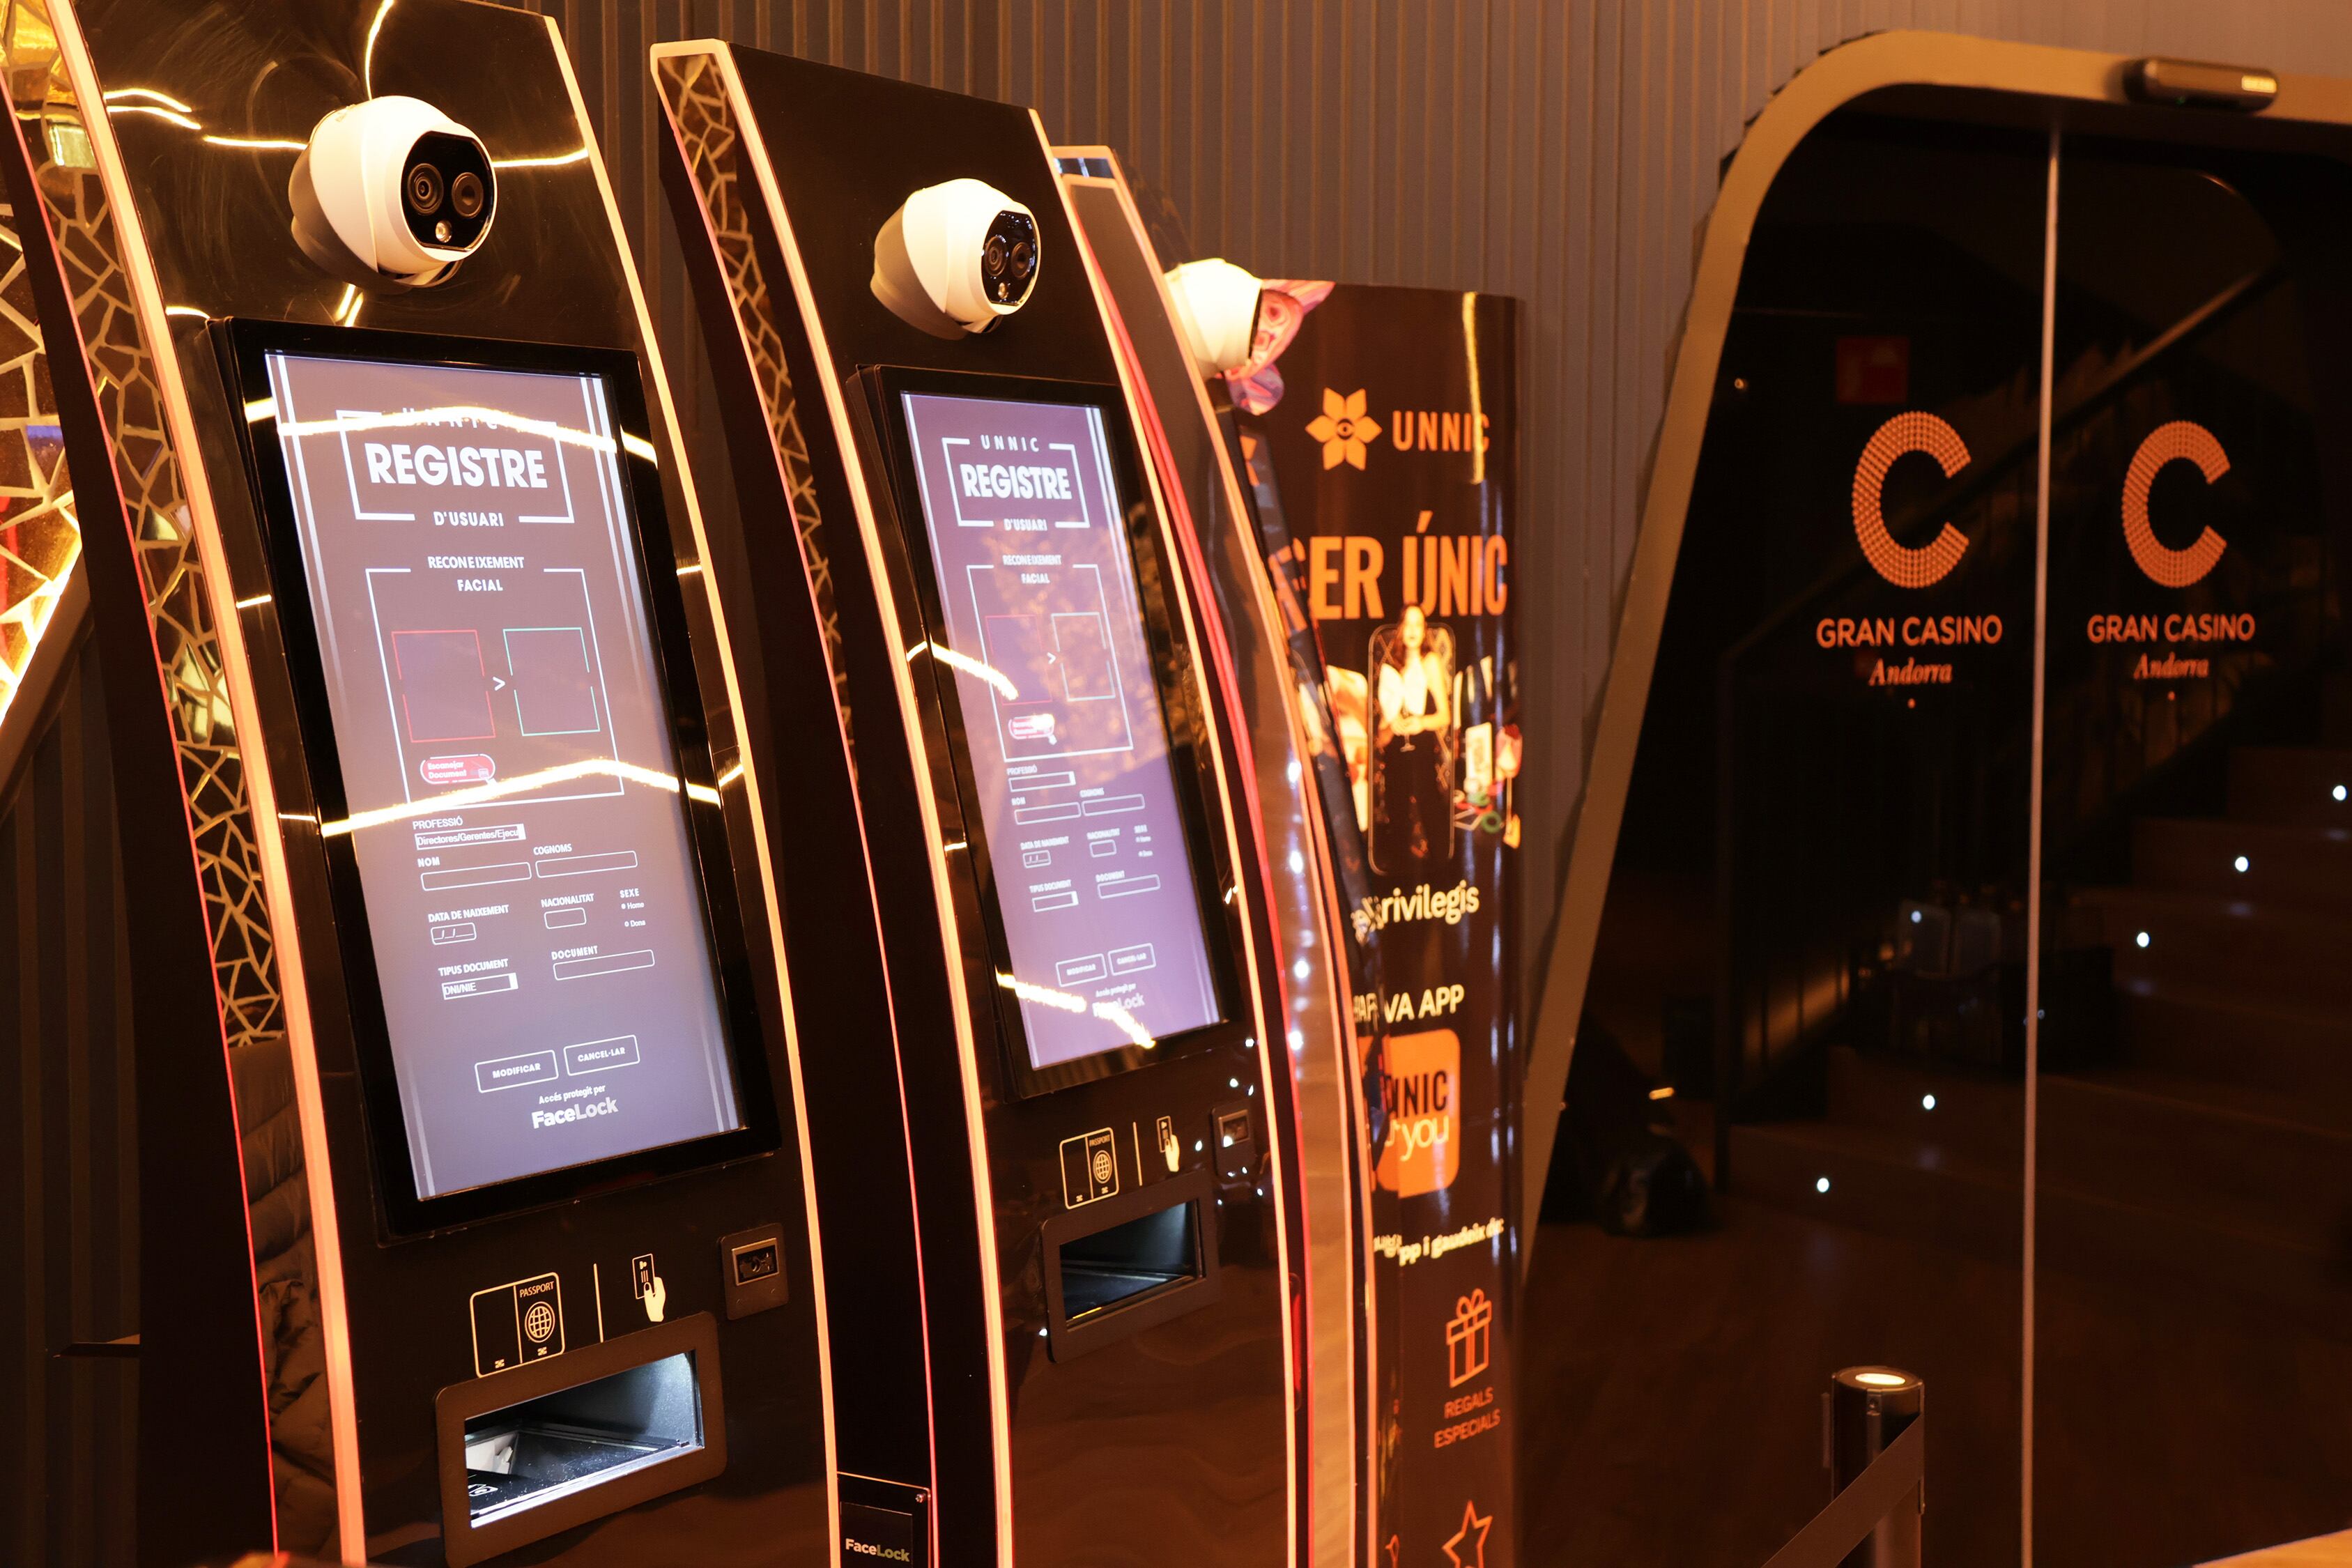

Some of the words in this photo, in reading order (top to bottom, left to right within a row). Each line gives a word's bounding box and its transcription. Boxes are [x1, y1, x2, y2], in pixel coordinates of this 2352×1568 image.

[1392, 410, 1490, 452] UNNIC
[981, 435, 1040, 452] UNNIC
[364, 443, 548, 489] REGISTRE
[960, 464, 1072, 500] REGISTRE
[1852, 411, 1971, 589] C
[2122, 420, 2230, 588] C
[433, 512, 504, 526] D'USUARI
[1004, 518, 1047, 531] D'USUARI
[427, 556, 525, 569] RECONEIXEMENT
[1294, 536, 1385, 620] ER
[1402, 510, 1508, 617] ÚNIC
[457, 579, 503, 591] FACIAL
[1021, 573, 1050, 584] FACIAL
[1816, 618, 1895, 649] GRAN
[1903, 615, 2002, 645] CASINO
[2087, 615, 2158, 643] GRAN
[2164, 613, 2255, 641] CASINO
[1868, 657, 1952, 686] Andorra
[2133, 652, 2209, 680] Andorra
[429, 769, 467, 779] Document
[413, 816, 463, 829] PROFESSIÓ
[533, 843, 573, 856] COGNOMS
[417, 856, 440, 868] NOM
[541, 893, 594, 907] NACIONALITAT
[620, 888, 640, 898] SEXE
[1376, 879, 1479, 925] rivilegis
[428, 912, 450, 923] DATA
[451, 911, 462, 920] DE
[463, 905, 509, 918] NAIXEMENT
[551, 946, 598, 960] DOCUMENT
[438, 964, 463, 976] TIPUS
[463, 958, 509, 973] DOCUMENT
[445, 982, 477, 995] DNI/NIE
[1384, 992, 1415, 1024] VA
[1417, 983, 1465, 1019] APP
[493, 1063, 541, 1078] MODIFICAR
[539, 1093, 562, 1104] Accés
[563, 1086, 593, 1101] protegit
[594, 1085, 606, 1096] per
[532, 1097, 619, 1129] FaceLock
[1399, 1115, 1450, 1162] you
[1399, 1243, 1422, 1267] pp
[519, 1281, 554, 1298] PASSPORT
[1444, 1386, 1494, 1419] REGALS
[1434, 1408, 1500, 1448] ESPECIALS
[845, 1538, 909, 1562] FaceLock
